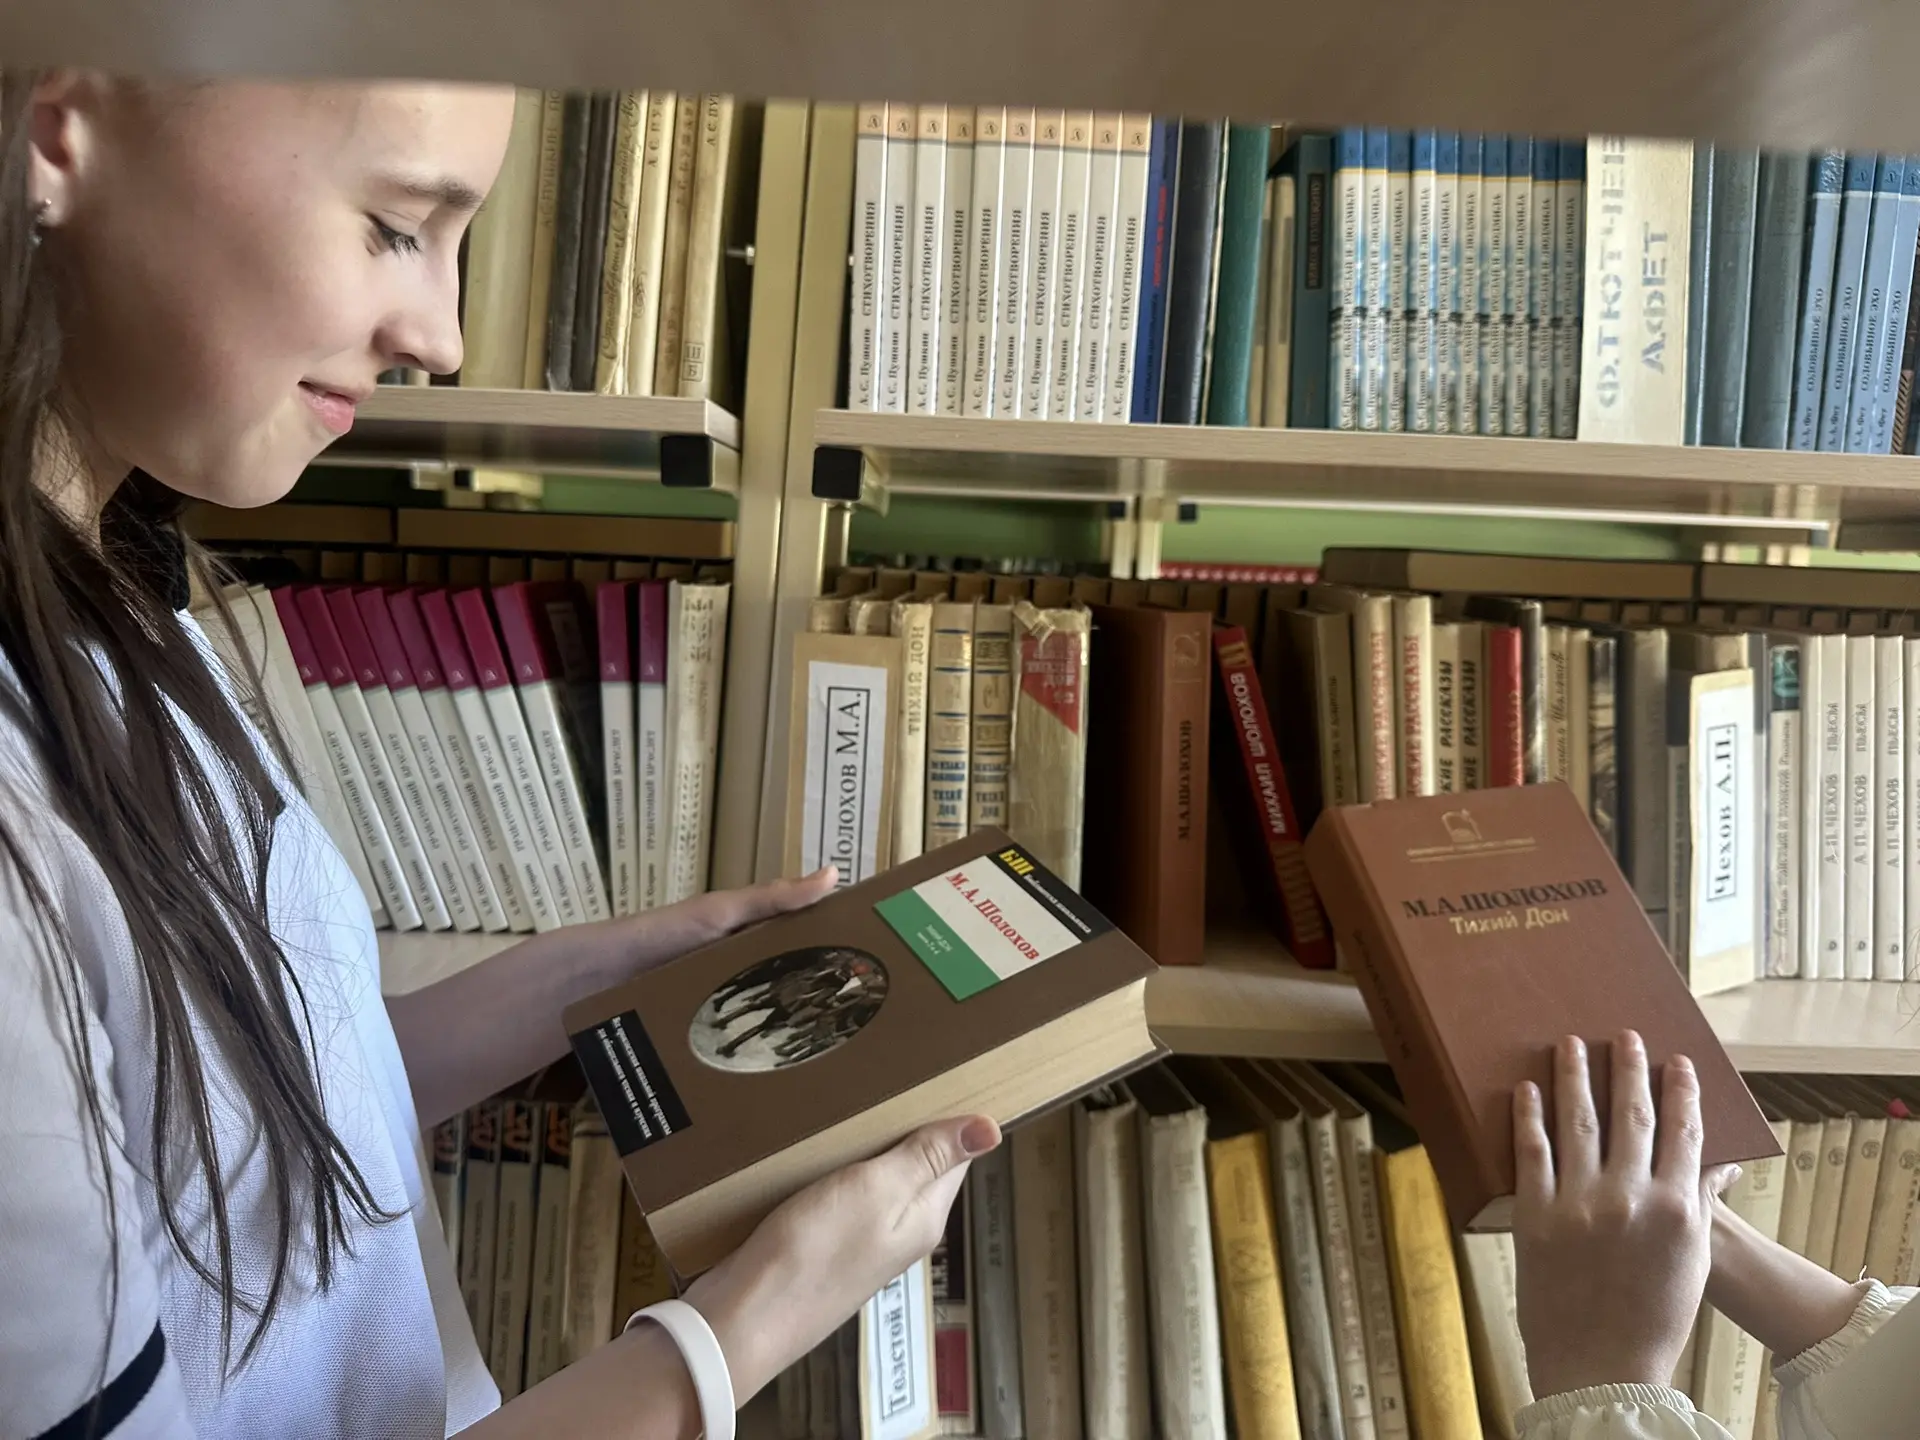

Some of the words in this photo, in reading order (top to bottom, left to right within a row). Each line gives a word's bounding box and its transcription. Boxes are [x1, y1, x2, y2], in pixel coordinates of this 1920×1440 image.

[862, 202, 875, 316] СТИХОТВОРЕНИЯ
[891, 205, 904, 320] СТИХОТВОРЕНИЯ
[921, 206, 934, 320] СТИХОТВОРЕНИЯ
[949, 209, 964, 324] СТИХОТВОРЕНИЯ
[977, 208, 991, 323] СТИХОТВОРЕНИЯ
[1006, 209, 1022, 324] СТИХОТВОРЕНИЯ
[1034, 212, 1050, 326] СТИХОТВОРЕНИЯ
[1061, 214, 1076, 327] СТИХОТВОРЕНИЯ
[1090, 216, 1106, 329] СТИХОТВОРЕНИЯ
[1120, 217, 1136, 330] СТИХОТВОРЕНИЯ
[860, 328, 872, 376] Пушкин
[888, 332, 900, 378] Пушкин
[918, 332, 930, 380] Пушкин
[948, 336, 959, 382] Пушкин
[974, 335, 986, 382] Пушкин
[1004, 336, 1016, 382] Пушкин
[1030, 338, 1043, 384] Пушкин
[1057, 340, 1068, 386] Пушкин
[1086, 342, 1098, 388] Пушкин
[1115, 342, 1128, 388] Пушкин
[1806, 316, 1821, 392] СОЛОВЬИНОЕ
[1814, 288, 1824, 312] ЭХО
[1834, 314, 1850, 390] СОЛОВЬИНОЕ
[1844, 287, 1853, 310] ЭХО
[1862, 316, 1877, 391] СОЛОВЬИНОЕ
[1870, 288, 1880, 312] ЭХО
[1882, 317, 1899, 392] СОЛОВЬИНОЕ
[1892, 290, 1902, 314] ЭХО
[909, 625, 926, 664] ДОН
[908, 671, 925, 737] ТИХИЙ
[1230, 671, 1267, 758] ШОЛОХОВ
[1403, 635, 1420, 732] РАССКАЗЫ
[1438, 660, 1454, 747] РАССКАЗЫ
[1462, 660, 1478, 747] РАССКАЗЫ
[836, 692, 863, 757] М.А.
[1827, 702, 1838, 752] ПЬЕСЫ
[1856, 704, 1867, 752] ПЬЕСЫ
[1887, 707, 1899, 756] ПЬЕСЫ
[1714, 726, 1734, 797] А.П.
[829, 763, 860, 886] Шолохов
[1254, 764, 1286, 834] МИХАИЛ
[1825, 774, 1838, 827] ЧЕХОВ
[1854, 774, 1867, 828] ЧЕХОВ
[1886, 778, 1899, 831] ЧЕХОВ
[999, 849, 1035, 876] БШ
[1714, 805, 1733, 895] Чехов
[946, 872, 970, 890] М.
[960, 888, 980, 904] А.
[974, 898, 1040, 960] Шолохов
[1402, 877, 1609, 921] М.А.ШОЛОХОВ
[1448, 913, 1520, 937] Тихий
[1524, 909, 1568, 932] Дон
[648, 1097, 673, 1136] программы
[885, 1306, 908, 1414] Толстой
